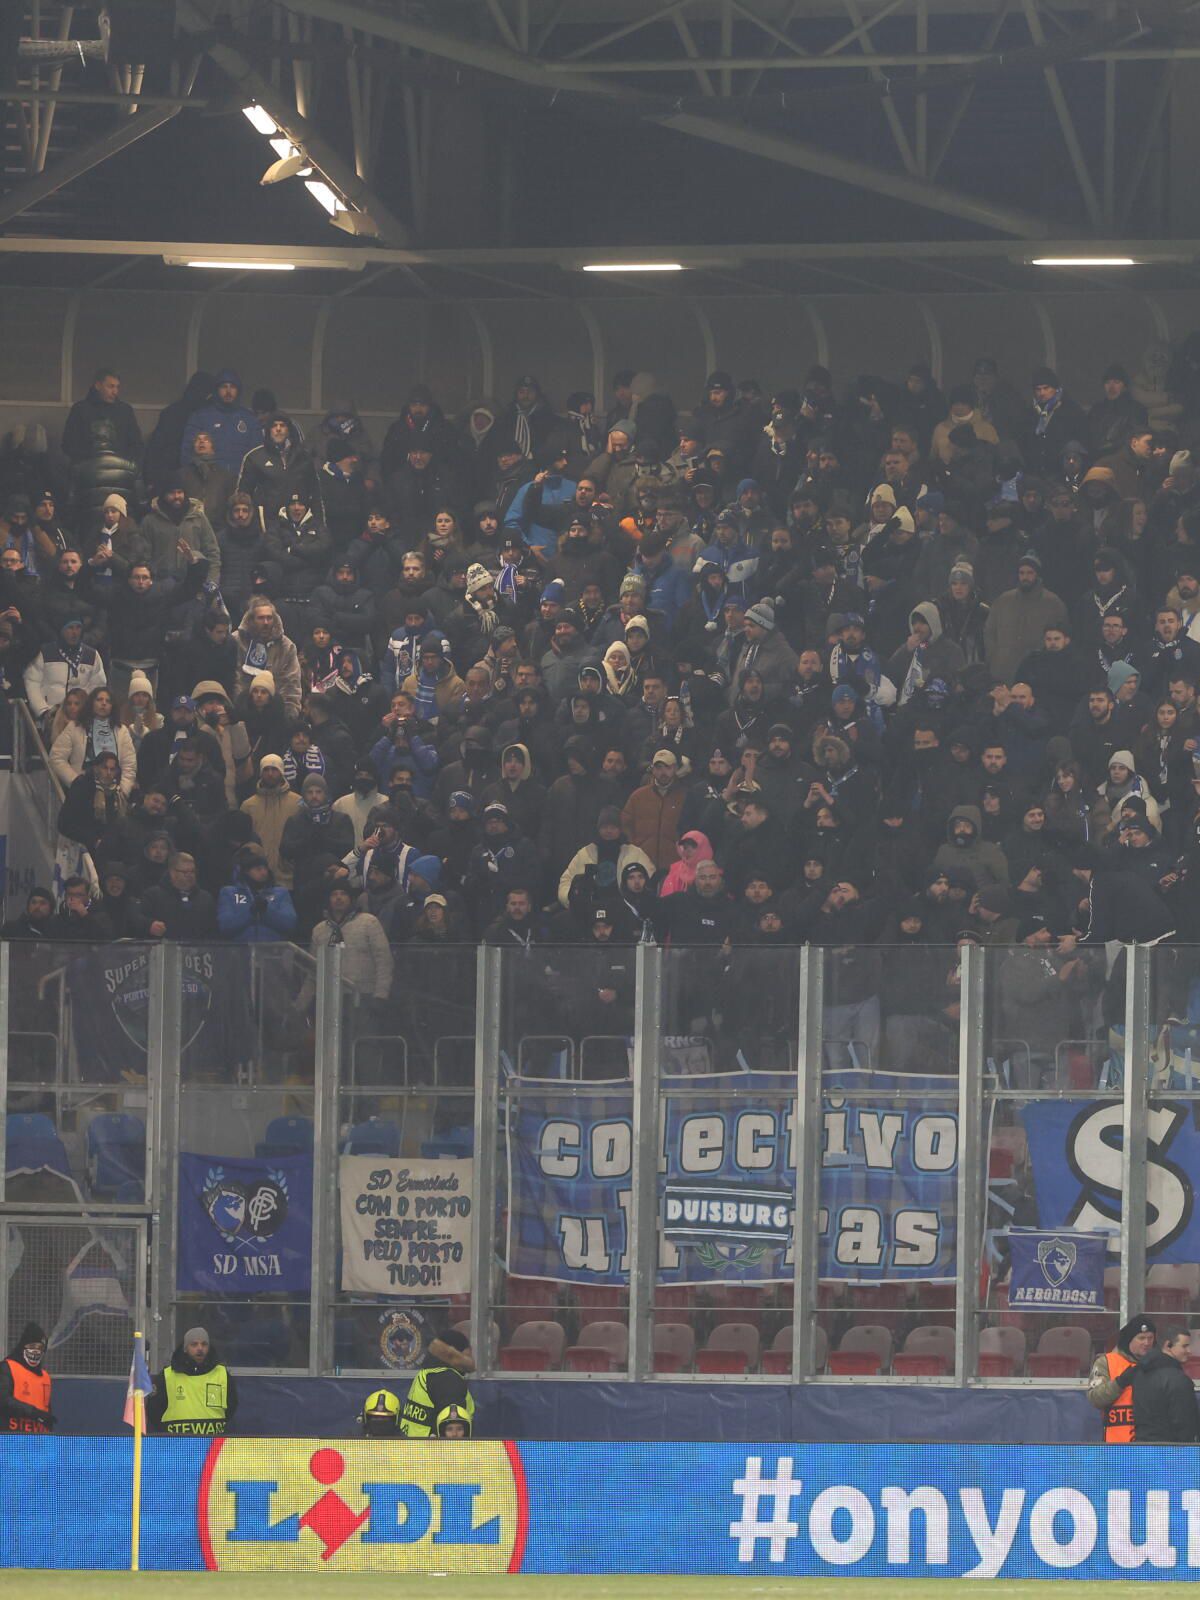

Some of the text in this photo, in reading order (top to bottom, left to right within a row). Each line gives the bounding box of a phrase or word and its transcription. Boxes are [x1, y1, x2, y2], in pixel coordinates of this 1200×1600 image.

[234, 893, 248, 905] 12
[104, 955, 147, 993] SUPER
[367, 1169, 393, 1190] SD
[356, 1194, 471, 1218] COM O PORTO
[666, 1199, 788, 1228] DUISBURG
[363, 1240, 463, 1263] PELO PORTO
[213, 1253, 283, 1276] SD MSA
[386, 1263, 442, 1287] TUDO!!
[1015, 1287, 1097, 1304] REBORDOSA
[403, 1403, 428, 1421] WARD
[9, 1417, 49, 1433] STEW
